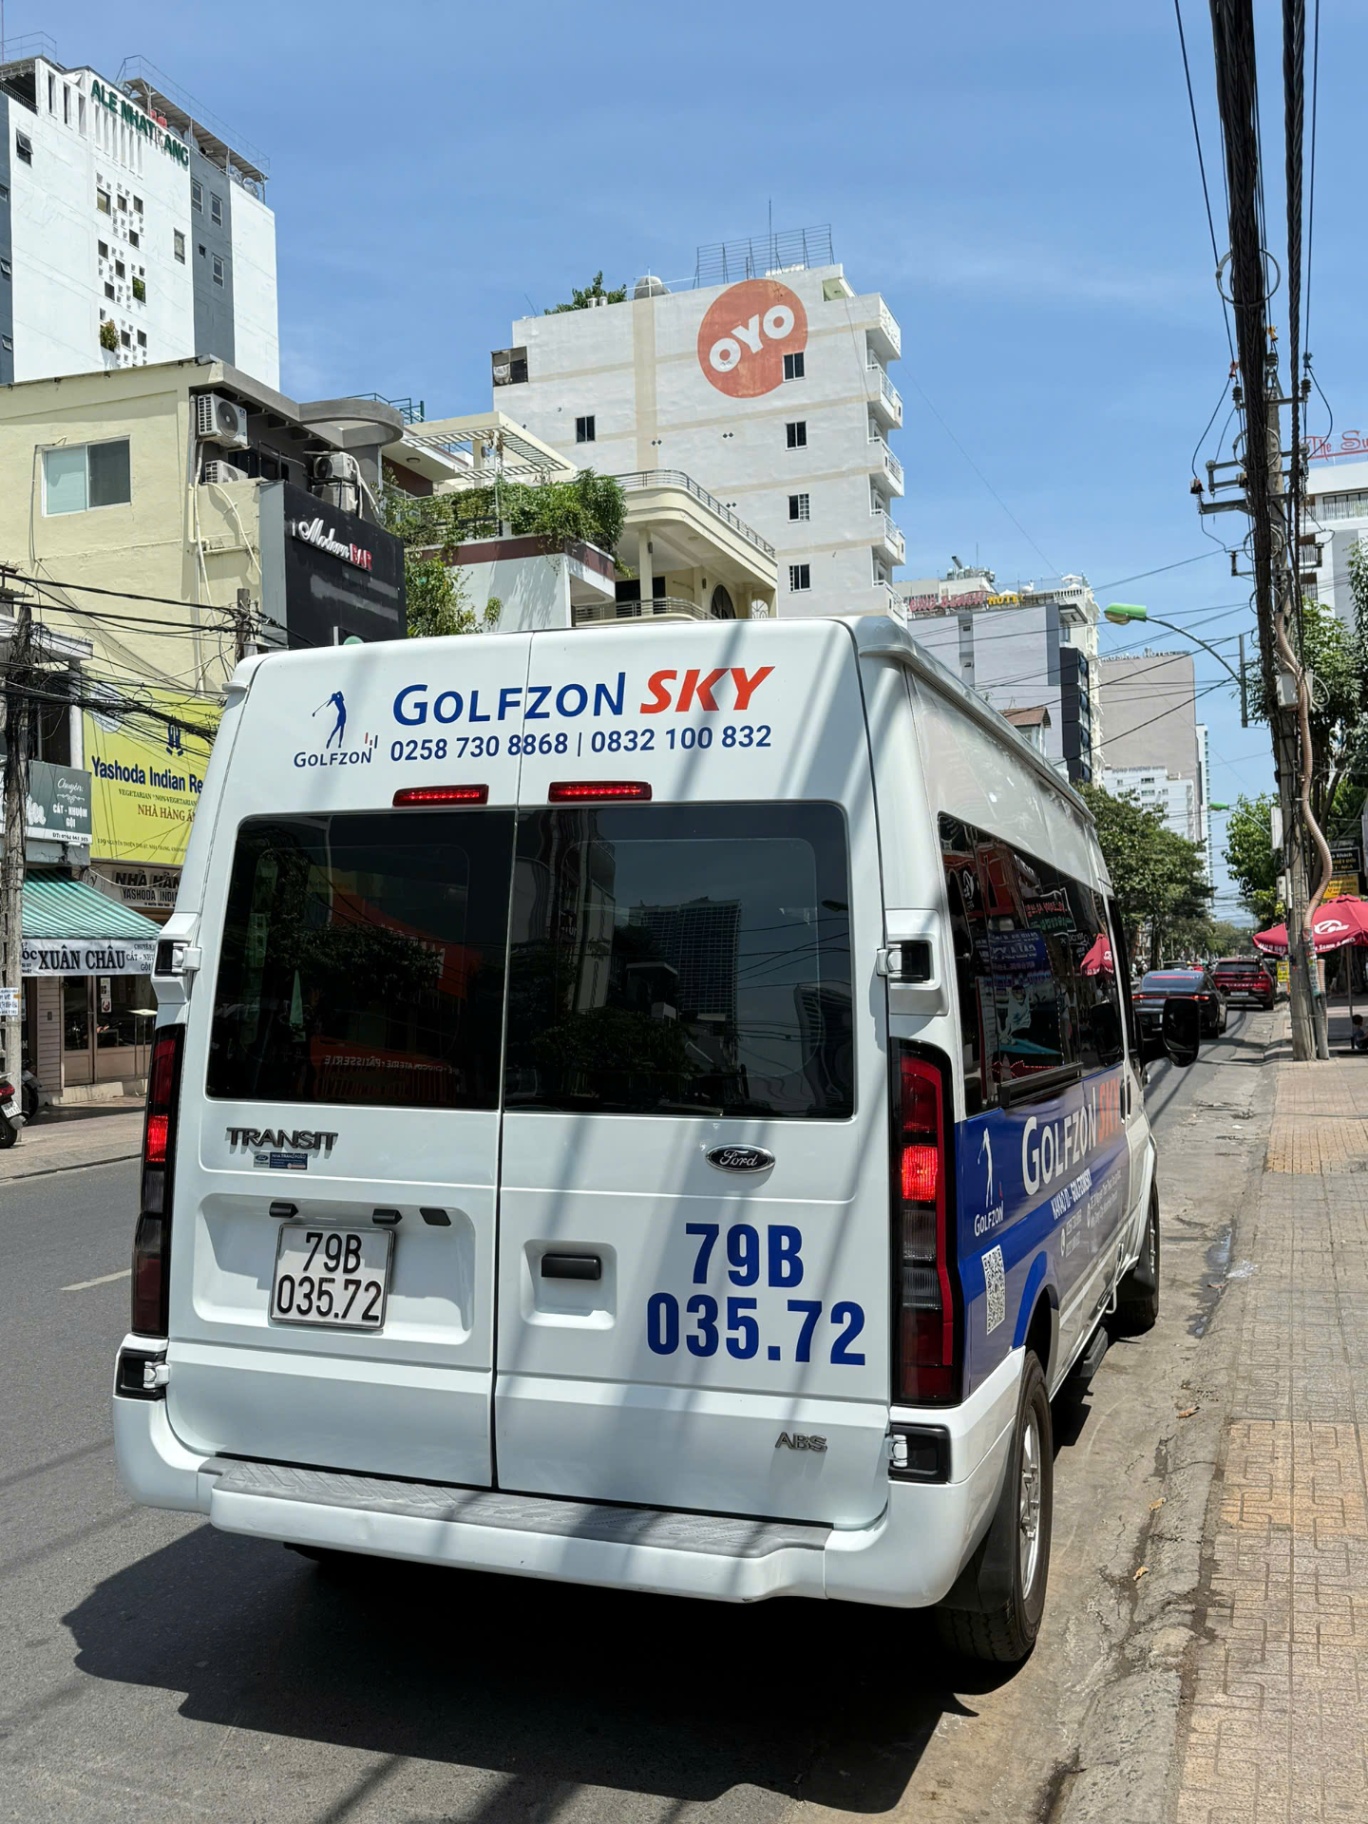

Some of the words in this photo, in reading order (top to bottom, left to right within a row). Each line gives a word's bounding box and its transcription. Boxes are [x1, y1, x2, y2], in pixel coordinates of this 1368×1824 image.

[91, 79, 118, 114] ALE
[709, 304, 795, 373] OYO
[1299, 435, 1332, 462] The
[298, 517, 350, 559] Modern
[349, 543, 373, 571] BAR
[392, 671, 626, 726] GOLFZON
[639, 666, 776, 714] SKY
[293, 747, 372, 768] GOLFZON
[390, 738, 448, 762] 0258
[456, 735, 500, 758] 730
[507, 731, 568, 757] 8868
[591, 728, 655, 753] 0832
[666, 726, 714, 750] 100
[721, 724, 772, 749] 832
[91, 755, 146, 785] Yashoda
[149, 765, 186, 792] Indian
[118, 788, 152, 801] VEGETARIAN
[137, 804, 159, 818] NHÀ
[160, 806, 185, 821] HÀNG
[187, 808, 196, 822] Ấ
[122, 887, 156, 901] YASHODA
[38, 944, 81, 970] XUÂN
[85, 944, 126, 970] CHÂU
[226, 1127, 339, 1151] TRANSIT
[1021, 1087, 1097, 1196] GOLFZON
[1098, 1076, 1121, 1143] SKY
[719, 1149, 759, 1166] Ford
[974, 1200, 1004, 1237] GOLFZON
[303, 1231, 362, 1274] 79B
[686, 1222, 804, 1288] 79B
[276, 1274, 382, 1322] 035.72
[647, 1292, 866, 1366] 035.72
[775, 1431, 828, 1453] ABS
